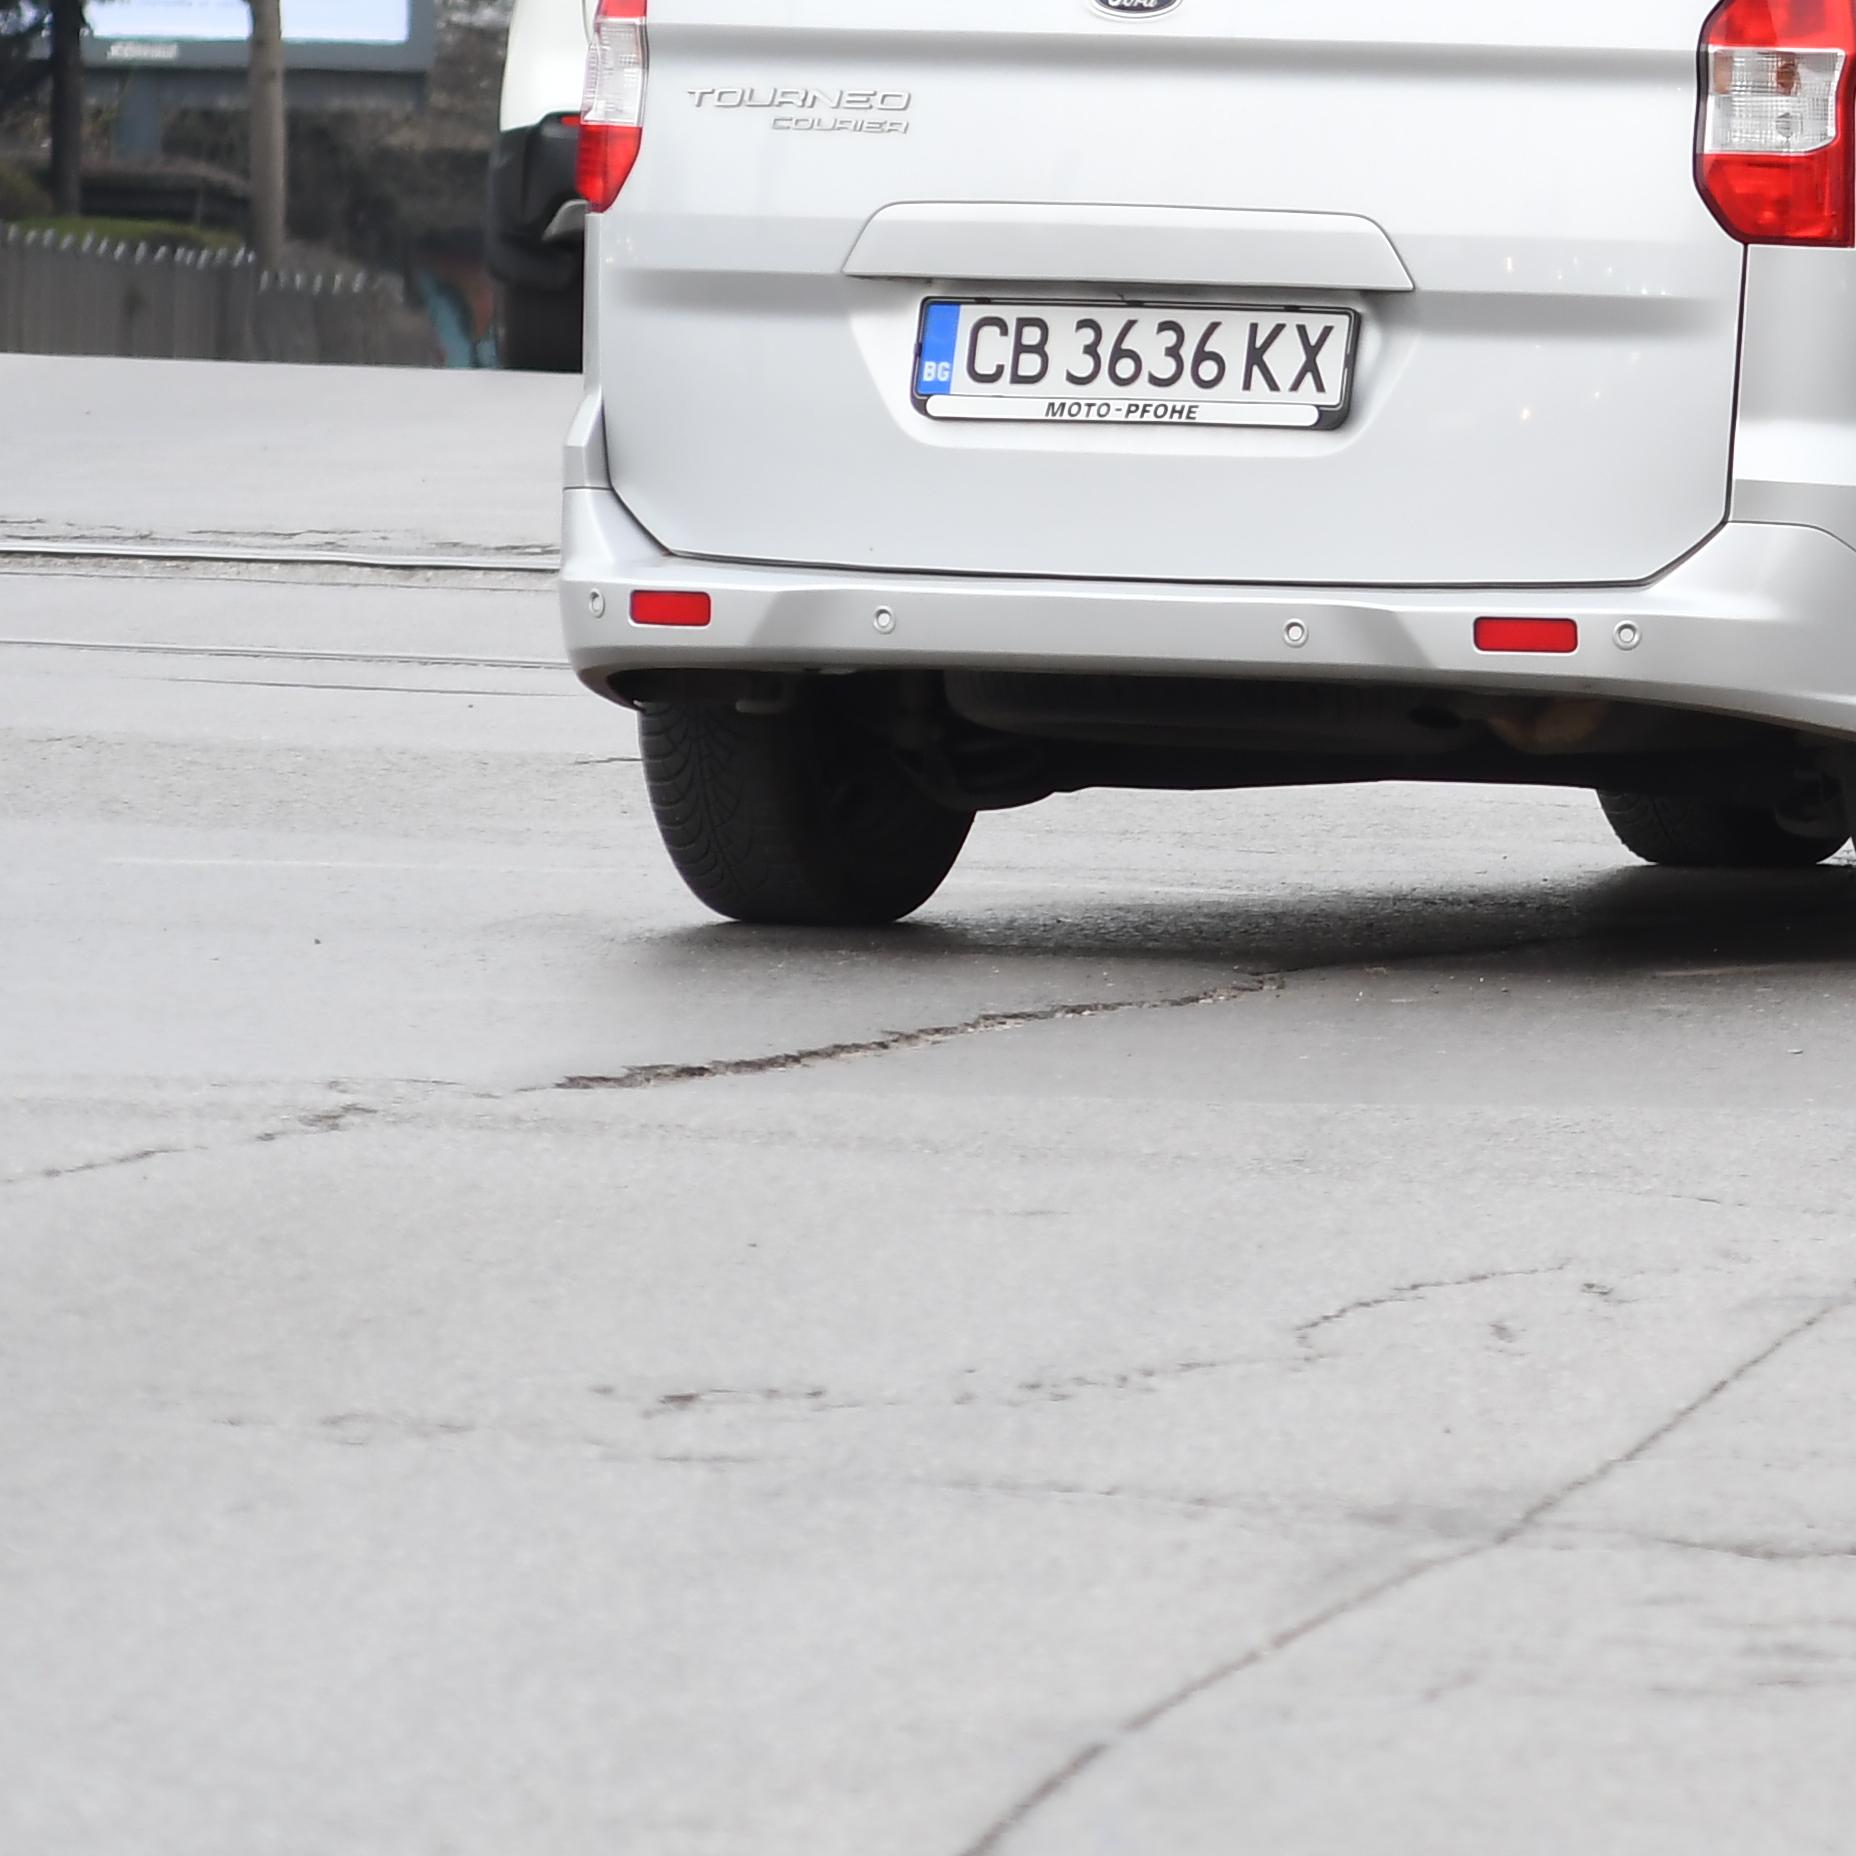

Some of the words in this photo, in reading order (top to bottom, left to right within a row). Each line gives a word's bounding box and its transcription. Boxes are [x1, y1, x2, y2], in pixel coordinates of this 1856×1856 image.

[687, 87, 912, 111] TOURNEO
[771, 117, 909, 135] COURIER
[966, 316, 1050, 386] CB
[1065, 317, 1227, 390] 3636
[1241, 321, 1335, 395] KX
[923, 360, 950, 383] BG
[1044, 402, 1200, 421] MOTO-PFOHE
